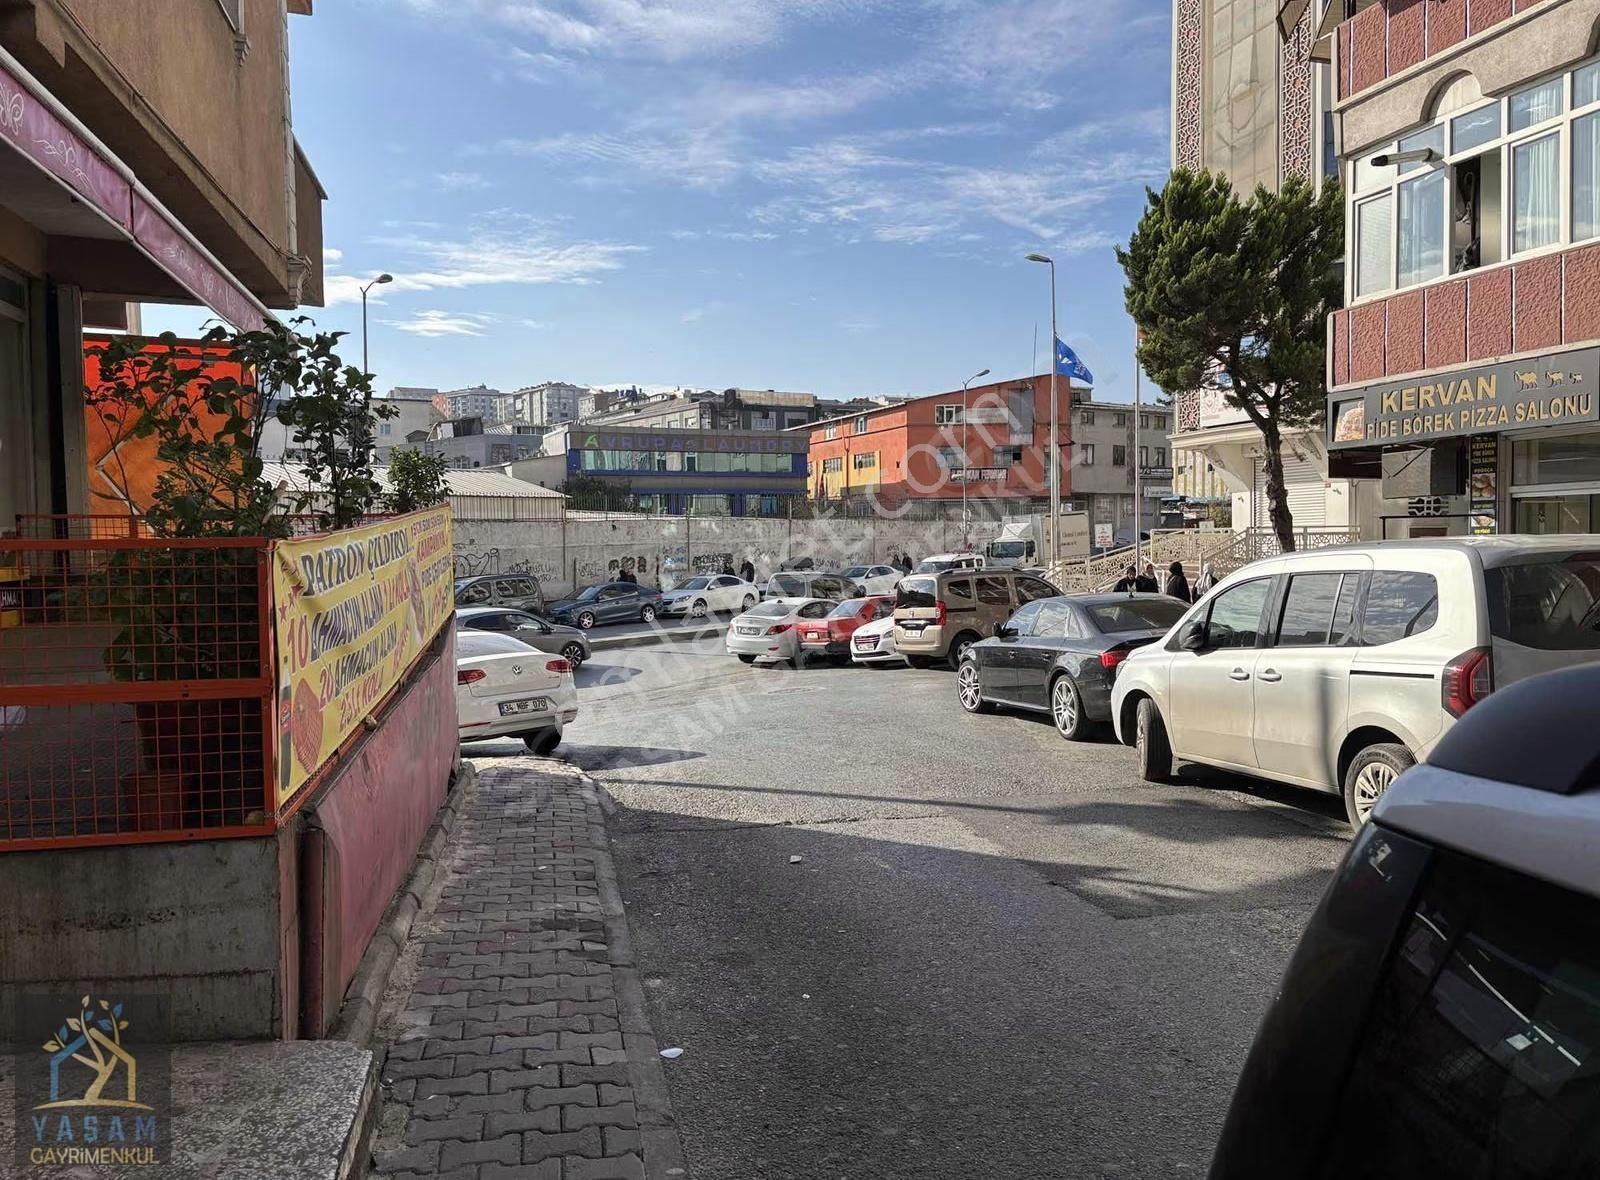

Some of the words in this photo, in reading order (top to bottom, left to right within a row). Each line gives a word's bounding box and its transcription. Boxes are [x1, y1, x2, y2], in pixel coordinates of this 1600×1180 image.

[1366, 416, 1397, 440] PİDE
[1402, 411, 1455, 436] BÖREK
[1460, 404, 1509, 429] PİZZA
[1515, 393, 1591, 422] SALONU
[1382, 374, 1496, 414] KERVAN
[584, 433, 682, 450] AVRUPA
[703, 438, 807, 451] LAUNDRY
[302, 543, 365, 596] PATRON
[288, 614, 309, 674] 10
